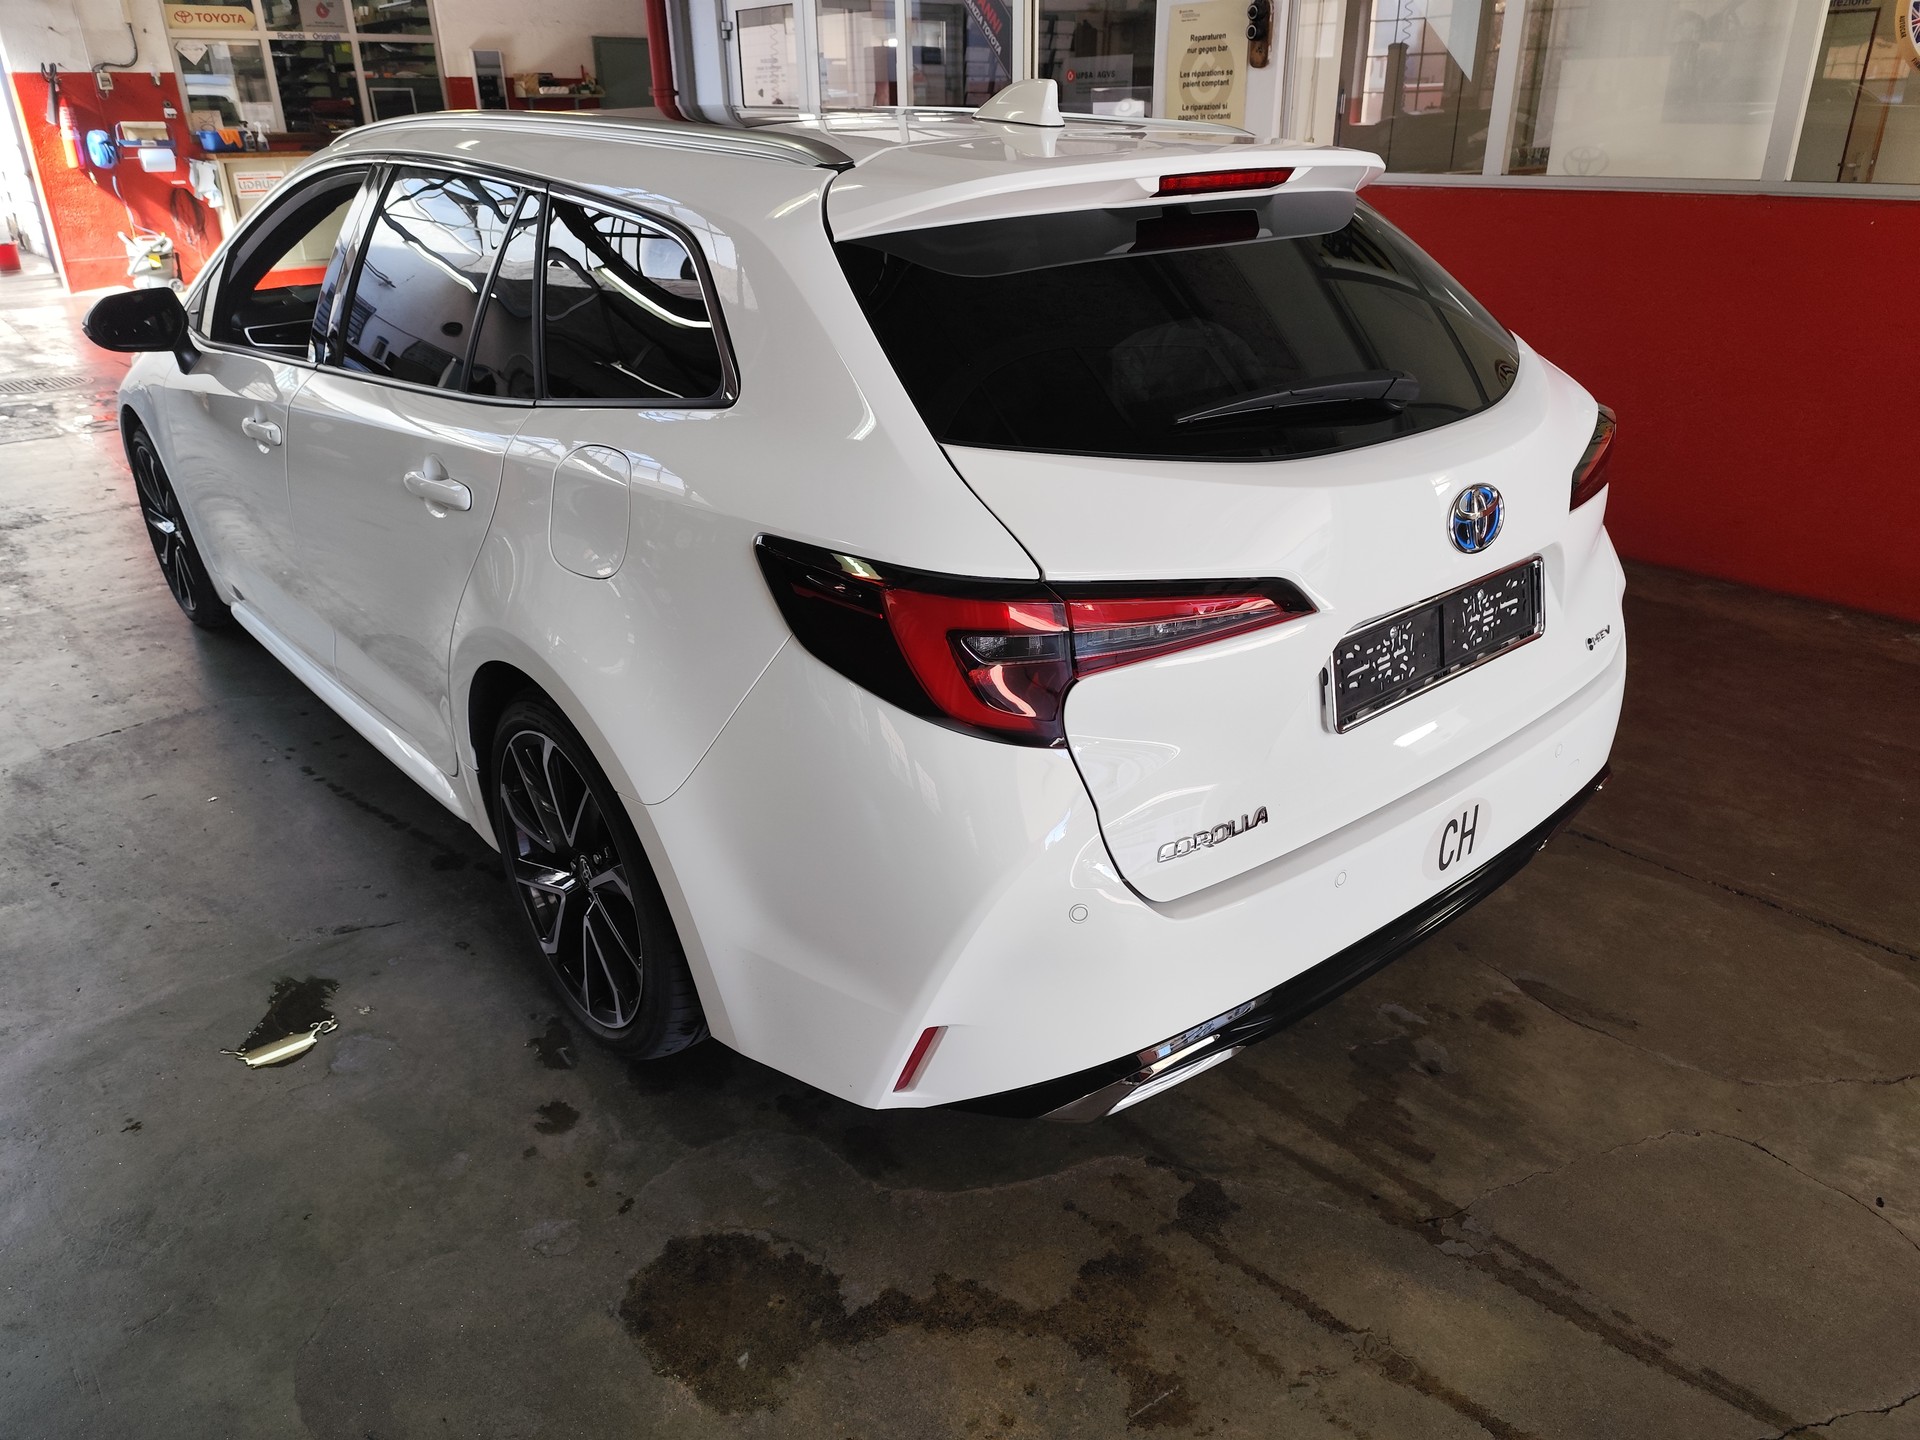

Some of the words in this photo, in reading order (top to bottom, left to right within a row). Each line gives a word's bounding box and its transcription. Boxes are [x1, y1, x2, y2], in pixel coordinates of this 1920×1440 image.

[195, 13, 246, 24] TOYOTA
[1899, 15, 1907, 39] AUTOCAR
[277, 32, 306, 40] Ricambi
[312, 32, 341, 41] Originali
[982, 21, 1002, 55] TOYOTA
[1190, 33, 1227, 43] Reparaturen
[1198, 46, 1217, 55] gegen
[1218, 44, 1228, 52] bar
[1076, 71, 1093, 79] UPSA
[1097, 70, 1116, 79] AGVS
[1191, 69, 1225, 79] réparations
[1182, 80, 1200, 89] paient
[1201, 79, 1230, 88] comptant
[1190, 102, 1221, 111] riparazioni
[1222, 102, 1228, 110] si
[1207, 112, 1231, 120] contanti
[1157, 805, 1269, 864] COROLLA
[1438, 804, 1479, 871] CH
